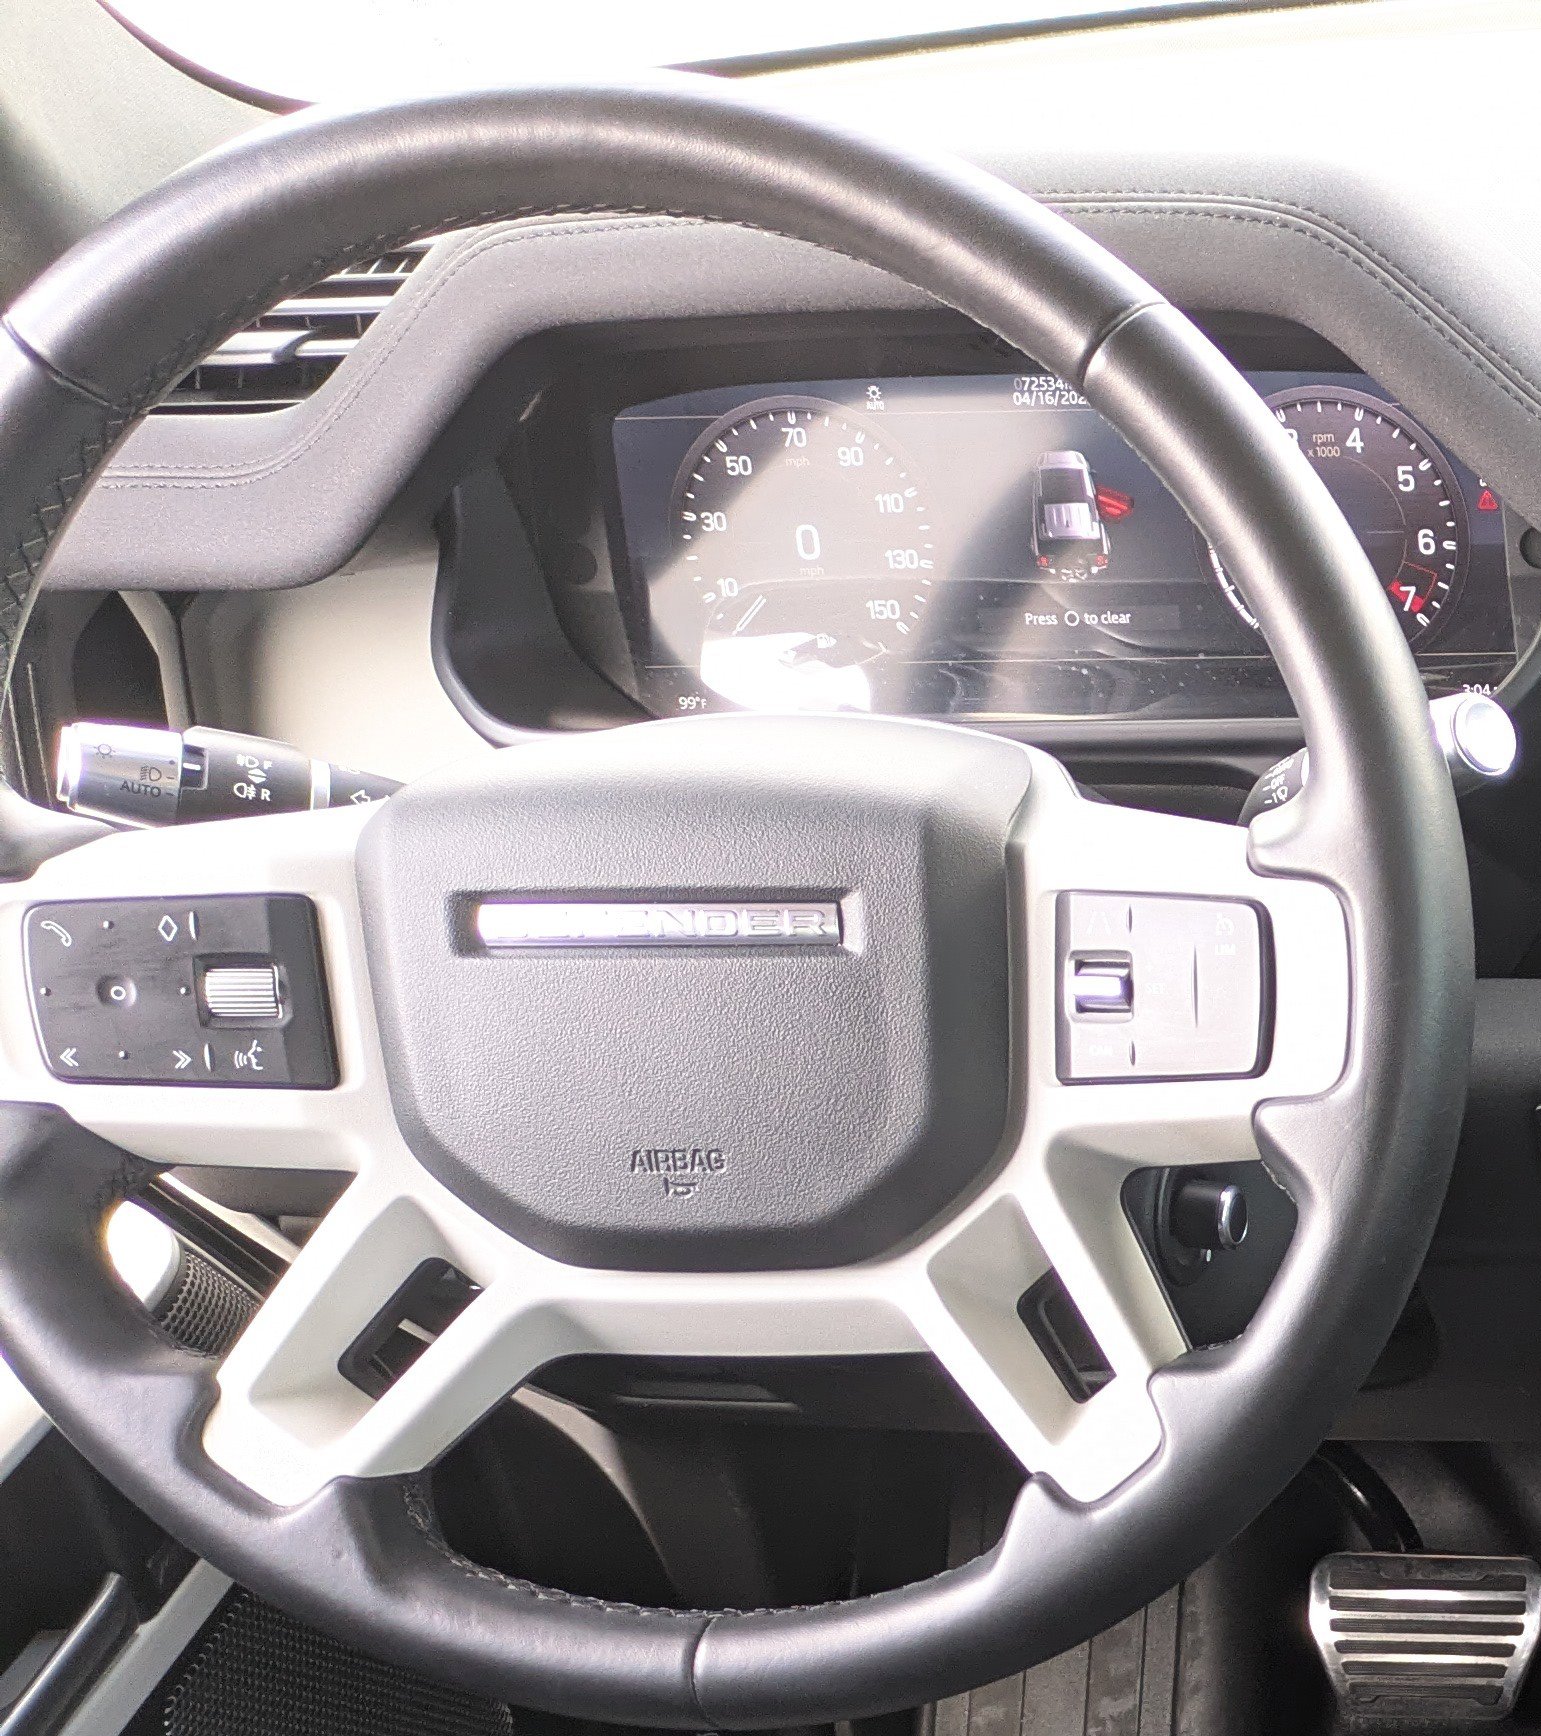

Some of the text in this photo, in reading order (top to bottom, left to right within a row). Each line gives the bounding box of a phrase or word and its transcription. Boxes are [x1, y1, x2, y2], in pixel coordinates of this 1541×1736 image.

[866, 401, 885, 411] AUTO
[1012, 390, 1087, 406] 04/16/202
[781, 428, 807, 448] 70
[1312, 432, 1335, 444] rpm
[1345, 428, 1364, 453] 4
[725, 456, 752, 476] 50
[785, 456, 810, 468] mph
[837, 447, 863, 467] 90
[1397, 466, 1415, 492] 5
[875, 493, 904, 514] 110
[700, 512, 727, 532] 30
[795, 524, 821, 560] 0
[1417, 529, 1436, 555] 6
[885, 550, 919, 570] 130
[800, 565, 825, 577] mph
[717, 578, 739, 597] 10
[1399, 585, 1416, 612] 7
[865, 599, 901, 620] 150
[1025, 611, 1131, 625] Press to clear
[678, 695, 707, 710] 99°F
[119, 780, 161, 798] AUTO
[497, 907, 828, 939] ENDER
[629, 1147, 727, 1174] AIRBAG
